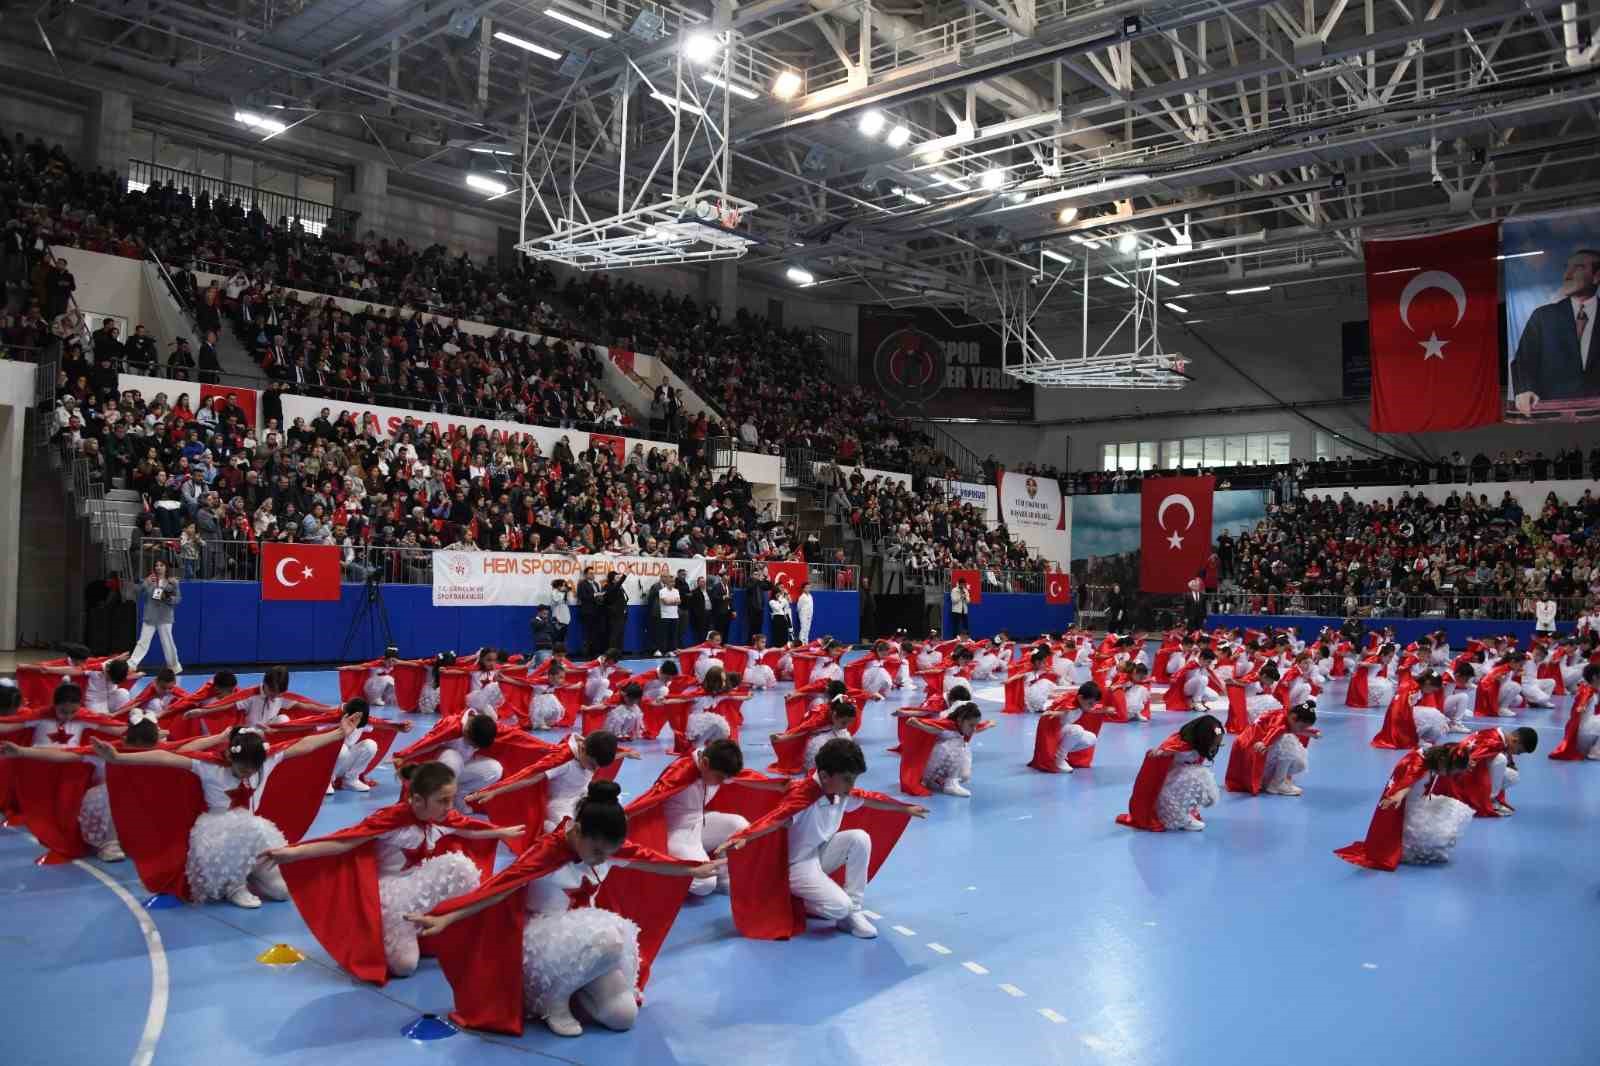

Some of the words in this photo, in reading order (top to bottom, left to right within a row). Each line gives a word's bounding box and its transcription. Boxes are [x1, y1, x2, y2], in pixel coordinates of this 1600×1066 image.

[483, 558, 518, 574] HEM
[521, 558, 581, 576] SPORDA
[617, 560, 671, 576] OKULDA
